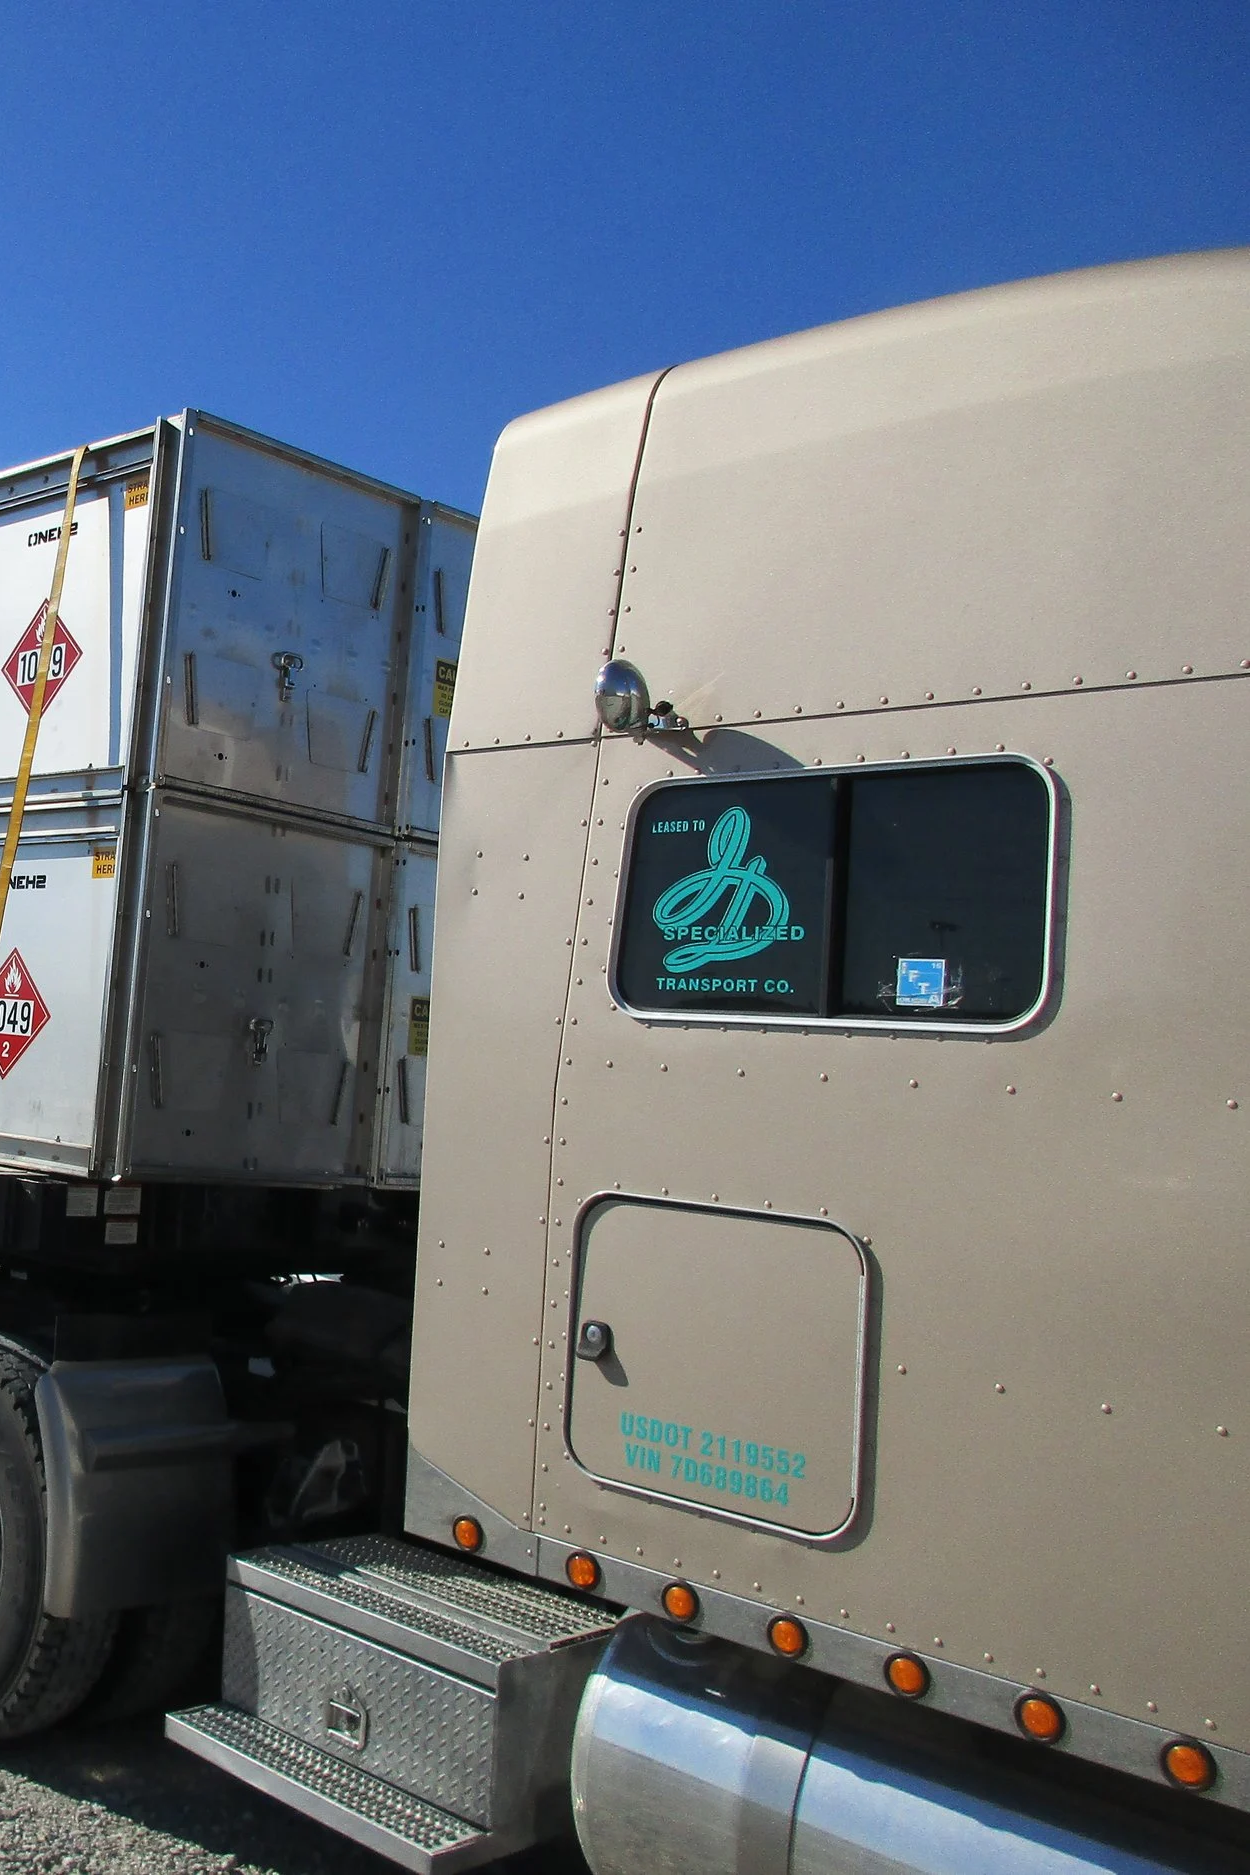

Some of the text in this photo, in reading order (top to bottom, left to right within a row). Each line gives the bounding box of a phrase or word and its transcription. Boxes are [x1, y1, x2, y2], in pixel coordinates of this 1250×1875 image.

[127, 481, 148, 493] STRA
[20, 646, 63, 684] 109
[652, 819, 706, 834] LEASED TO
[94, 851, 116, 861] STRA
[8, 874, 47, 890] NEH2
[663, 925, 805, 941] SPECIALIZED
[656, 977, 795, 993] TRANSPORT CO.
[414, 1004, 429, 1018] CA
[1, 1041, 10, 1058] 2
[620, 1411, 806, 1479] USDOT 2119552
[624, 1442, 789, 1507] VIN 7D689864
